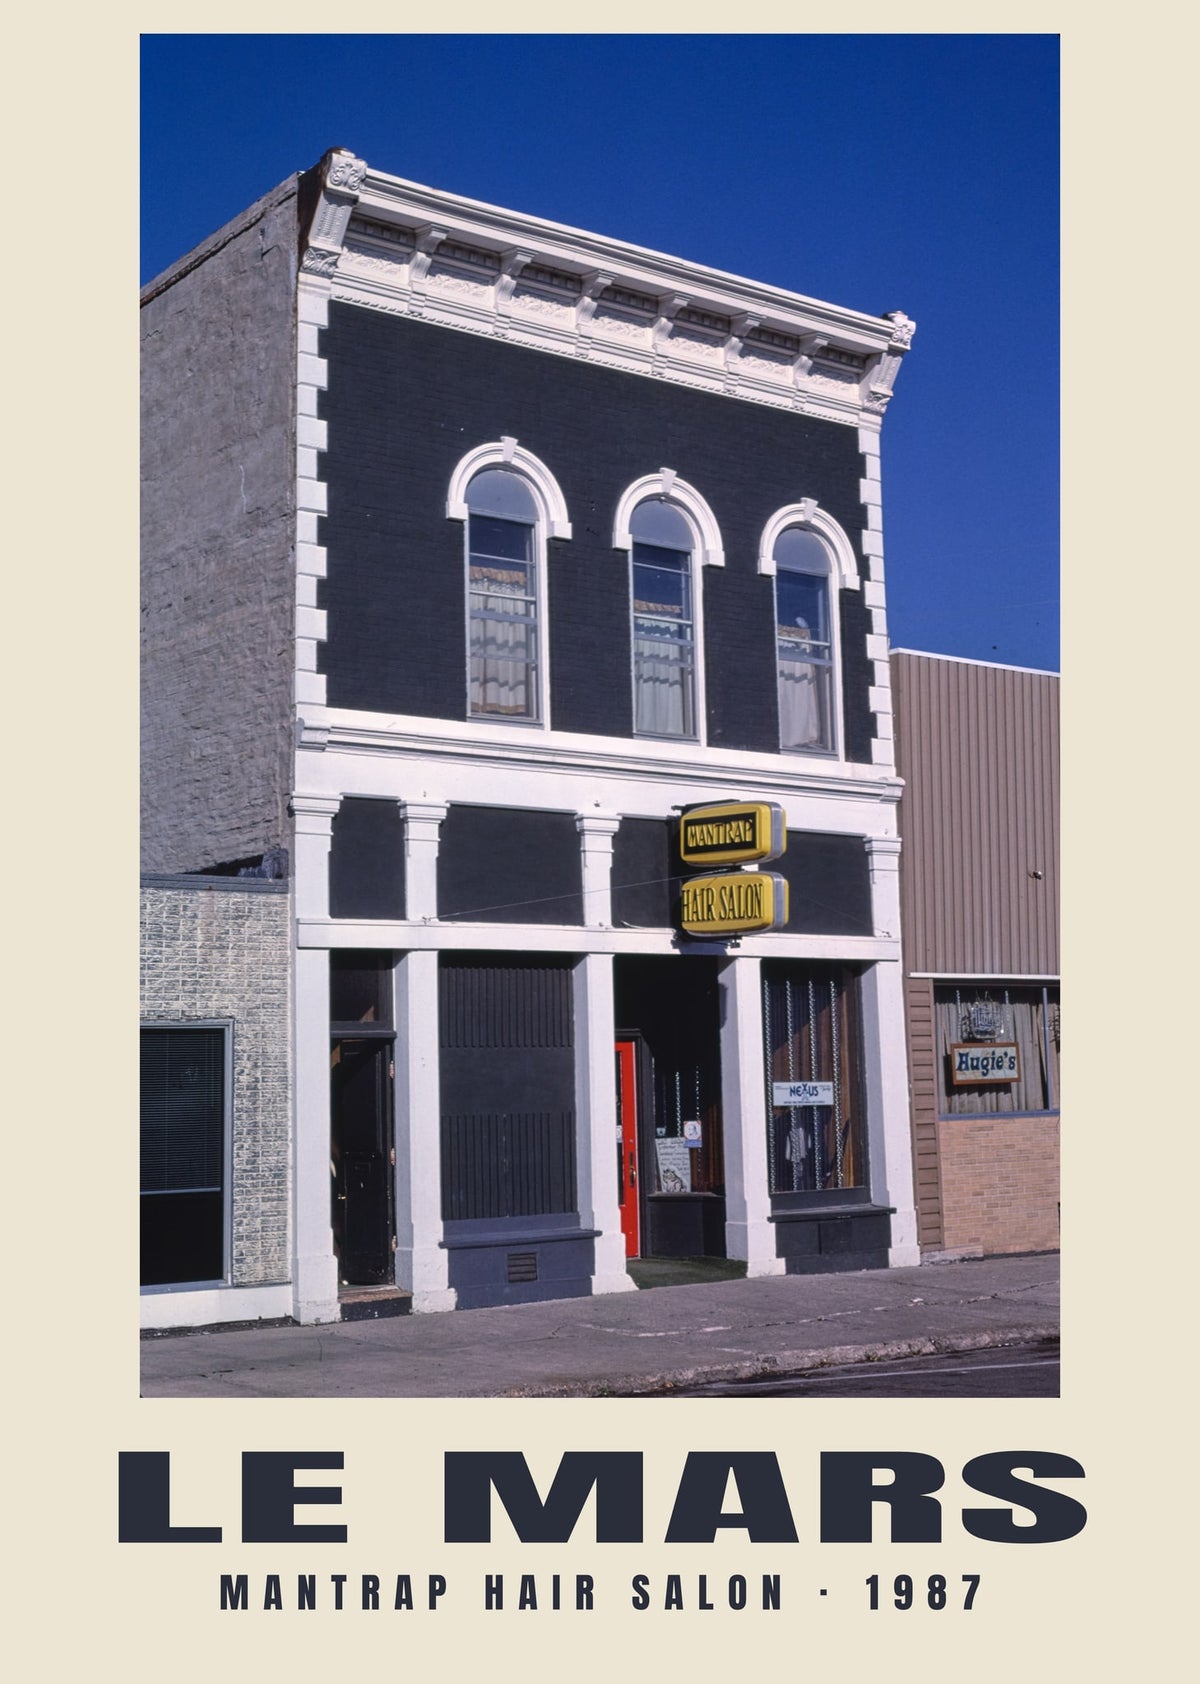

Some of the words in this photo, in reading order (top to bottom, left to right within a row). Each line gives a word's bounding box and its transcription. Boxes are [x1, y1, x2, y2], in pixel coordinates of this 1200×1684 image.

[687, 818, 753, 847] MANTRAP
[682, 887, 715, 922] HAIR
[719, 883, 763, 921] SALON
[956, 1050, 1016, 1076] Augie's
[789, 1083, 819, 1097] NEXUS
